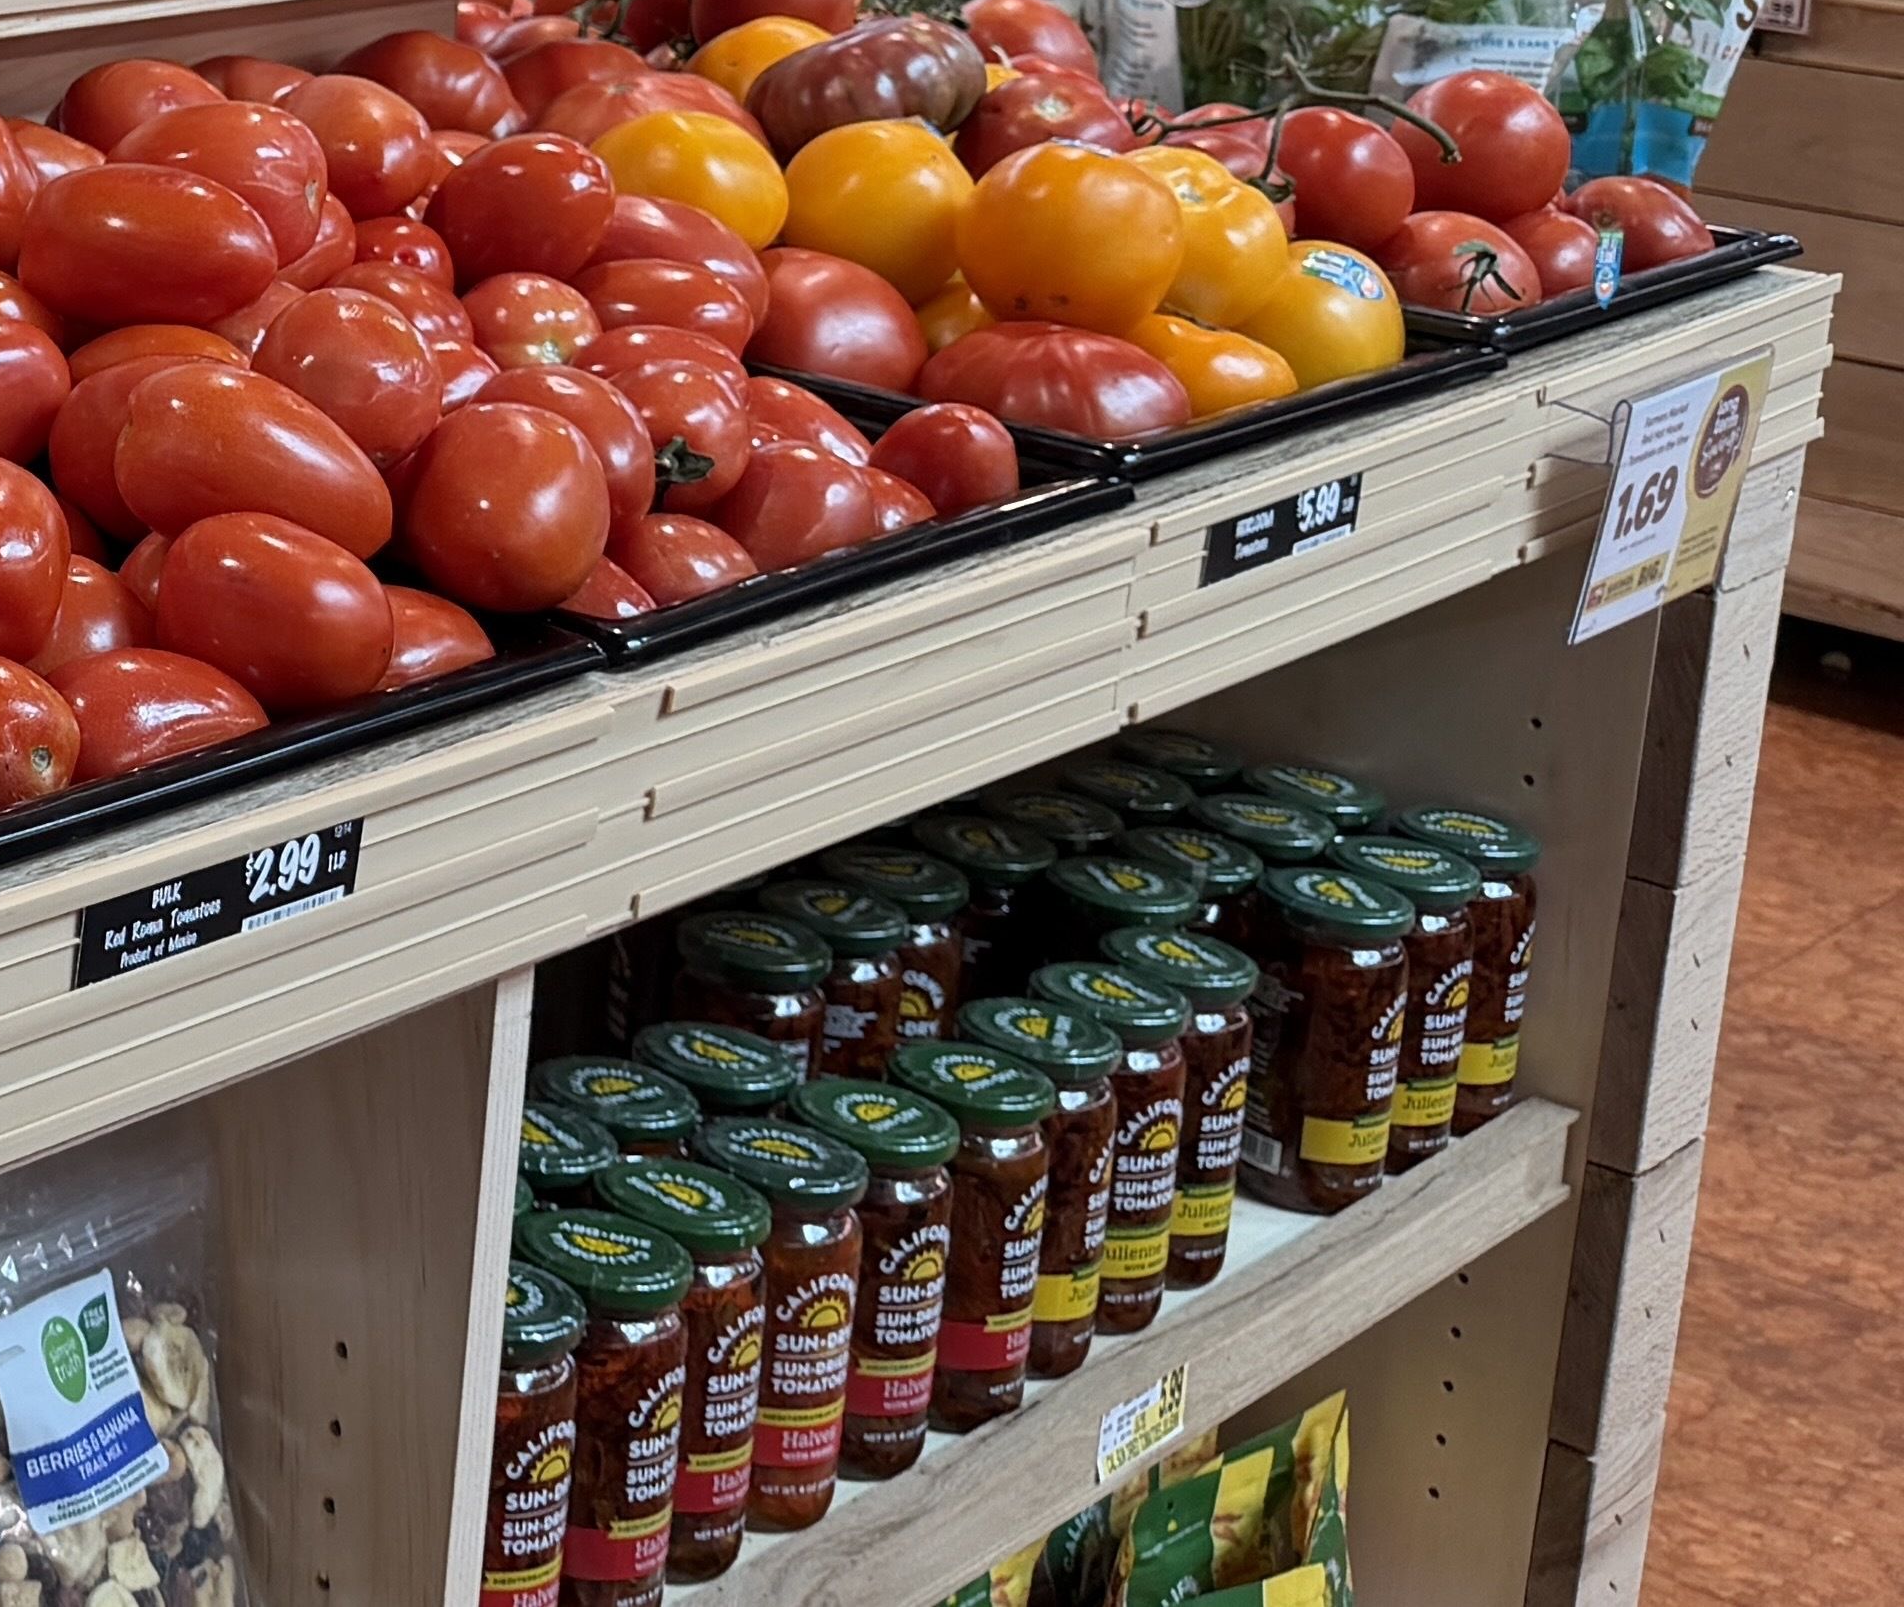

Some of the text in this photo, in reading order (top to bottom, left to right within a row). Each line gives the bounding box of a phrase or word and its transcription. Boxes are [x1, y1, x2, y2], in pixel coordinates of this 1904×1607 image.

[1612, 464, 1679, 541] 1.69
[244, 832, 321, 904] $2.99
[151, 881, 182, 910] BULK
[104, 897, 222, 951] Red Roma Tomatoes
[119, 930, 198, 970] Product of Mexico
[1201, 1056, 1251, 1107] CALIFO
[1116, 1097, 1183, 1146] CALIFO
[1113, 1189, 1175, 1212] TOMATO
[879, 1224, 950, 1275] CALIFO
[1103, 1240, 1162, 1262] ulienne
[707, 1304, 766, 1365] CALIFO
[874, 1319, 942, 1345] TOMATO
[53, 1354, 84, 1384] truth
[770, 1368, 848, 1396] TOMATOE
[628, 1364, 687, 1429] CALIFO
[26, 1406, 141, 1478] BERRIES & BANANA
[505, 1419, 577, 1481] CALIFO
[77, 1455, 109, 1481] TRAIL
[501, 1525, 566, 1557] TOMATO
